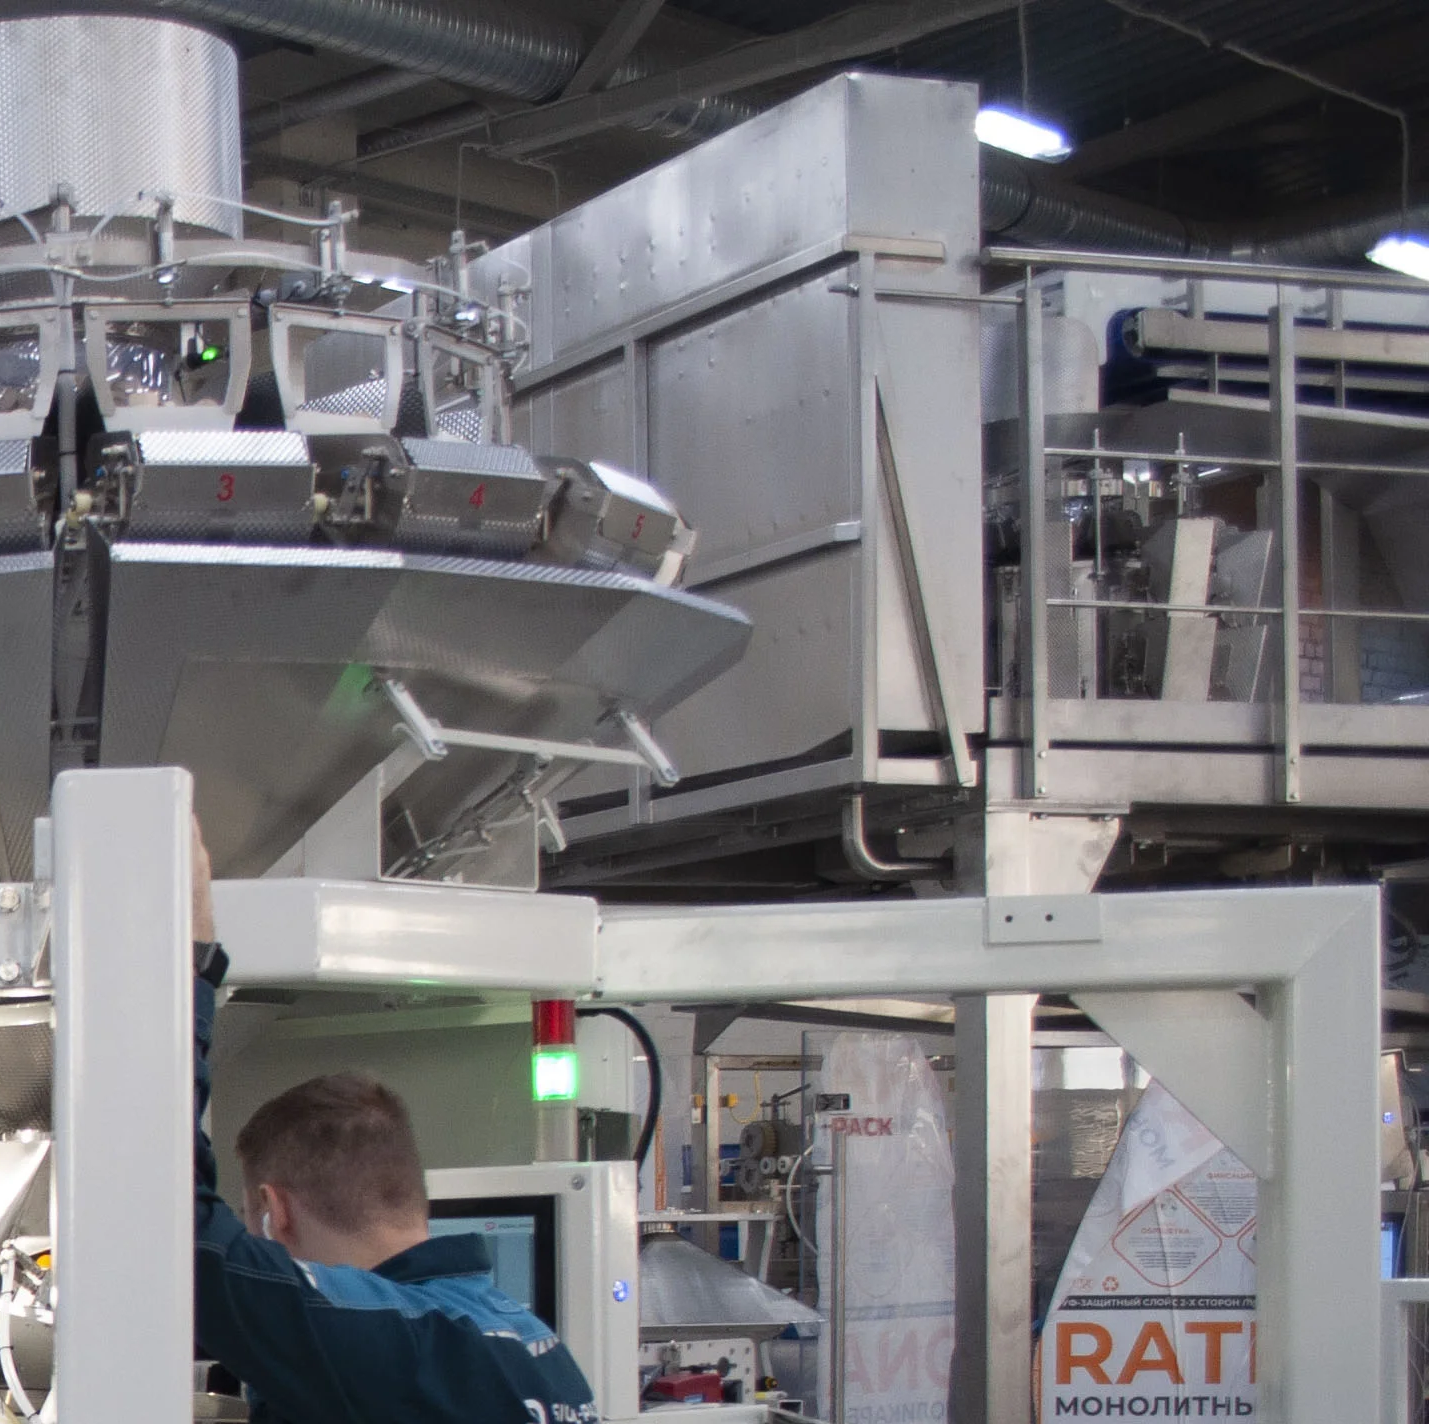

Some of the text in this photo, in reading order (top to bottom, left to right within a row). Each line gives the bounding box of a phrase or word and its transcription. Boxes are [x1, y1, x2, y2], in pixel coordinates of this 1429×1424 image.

[216, 473, 236, 501] 3
[468, 483, 487, 509] 4
[1197, 1298, 1240, 1308] СТОРОН
